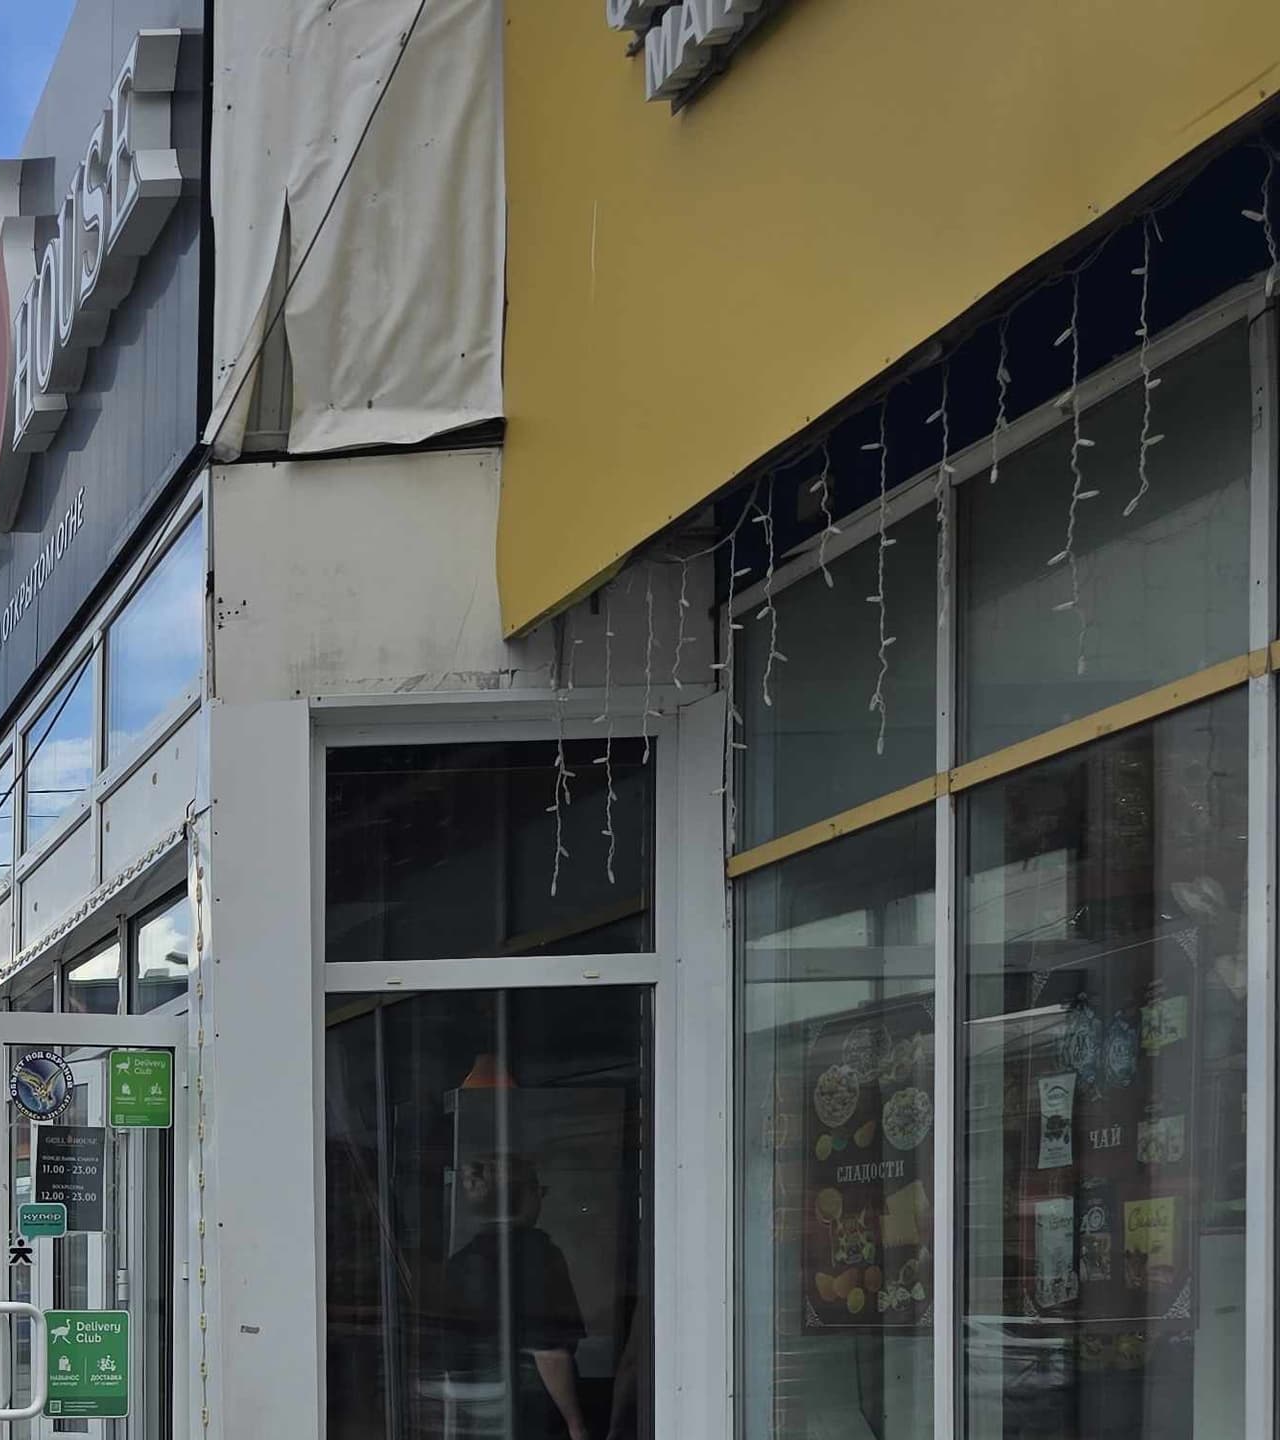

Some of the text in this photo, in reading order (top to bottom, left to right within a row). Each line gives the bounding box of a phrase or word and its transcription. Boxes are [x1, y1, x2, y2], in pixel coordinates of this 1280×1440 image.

[12, 30, 162, 452] HOUSE
[2, 536, 55, 642] ОТКРЫТОМ
[57, 486, 86, 561] ОГНЕ
[134, 1058, 166, 1068] Delivery
[11, 1051, 73, 1097] ОБЪЕКТ ПОД ОХРАНОЙ
[134, 1067, 152, 1075] Club
[1090, 1123, 1121, 1150] ЧАЙ
[42, 1164, 65, 1174] 11.00
[72, 1165, 97, 1175] 23.00
[836, 1160, 905, 1183] СЛАДОСТИ
[41, 1191, 64, 1200] 12.00
[72, 1192, 97, 1201] 23.00
[76, 1320, 121, 1333] Delivery
[76, 1333, 102, 1343] Club
